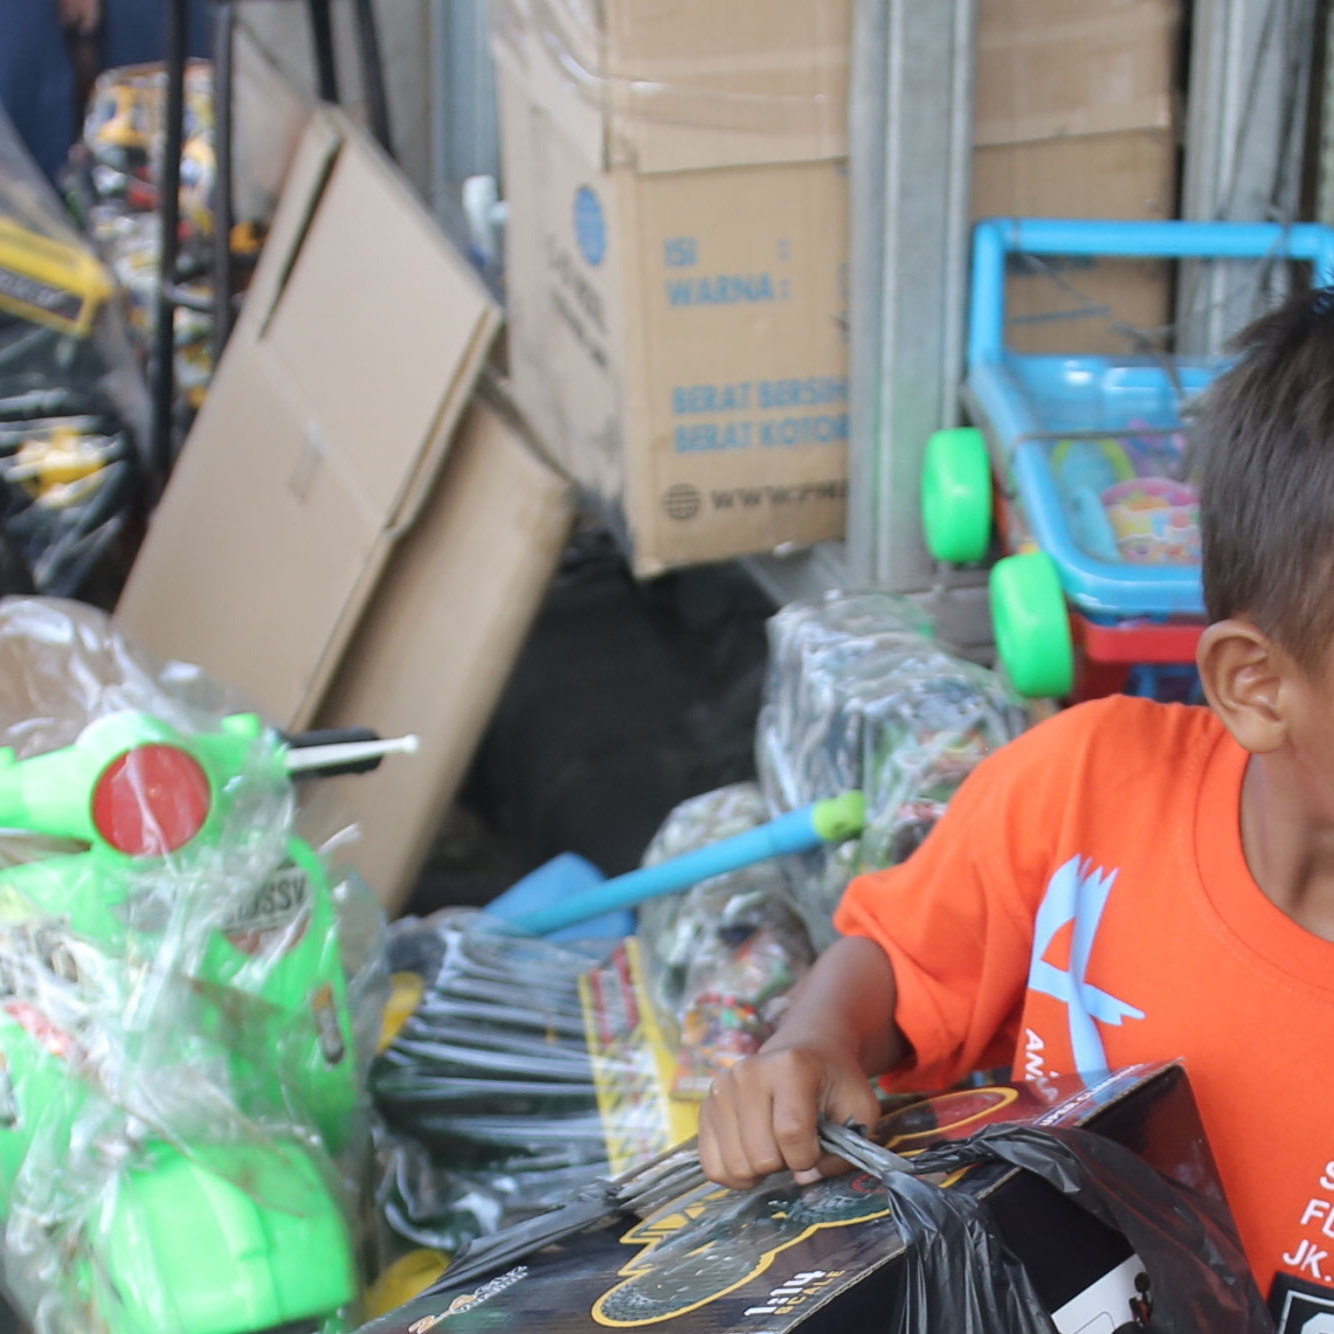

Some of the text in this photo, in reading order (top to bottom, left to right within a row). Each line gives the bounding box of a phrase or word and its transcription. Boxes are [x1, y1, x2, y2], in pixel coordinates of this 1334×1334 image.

[665, 273, 775, 306] WARNA
[673, 383, 752, 414] BERAT
[675, 420, 754, 453] BERAT
[744, 1271, 826, 1316] 1:14
[774, 1270, 846, 1315] SCALE
